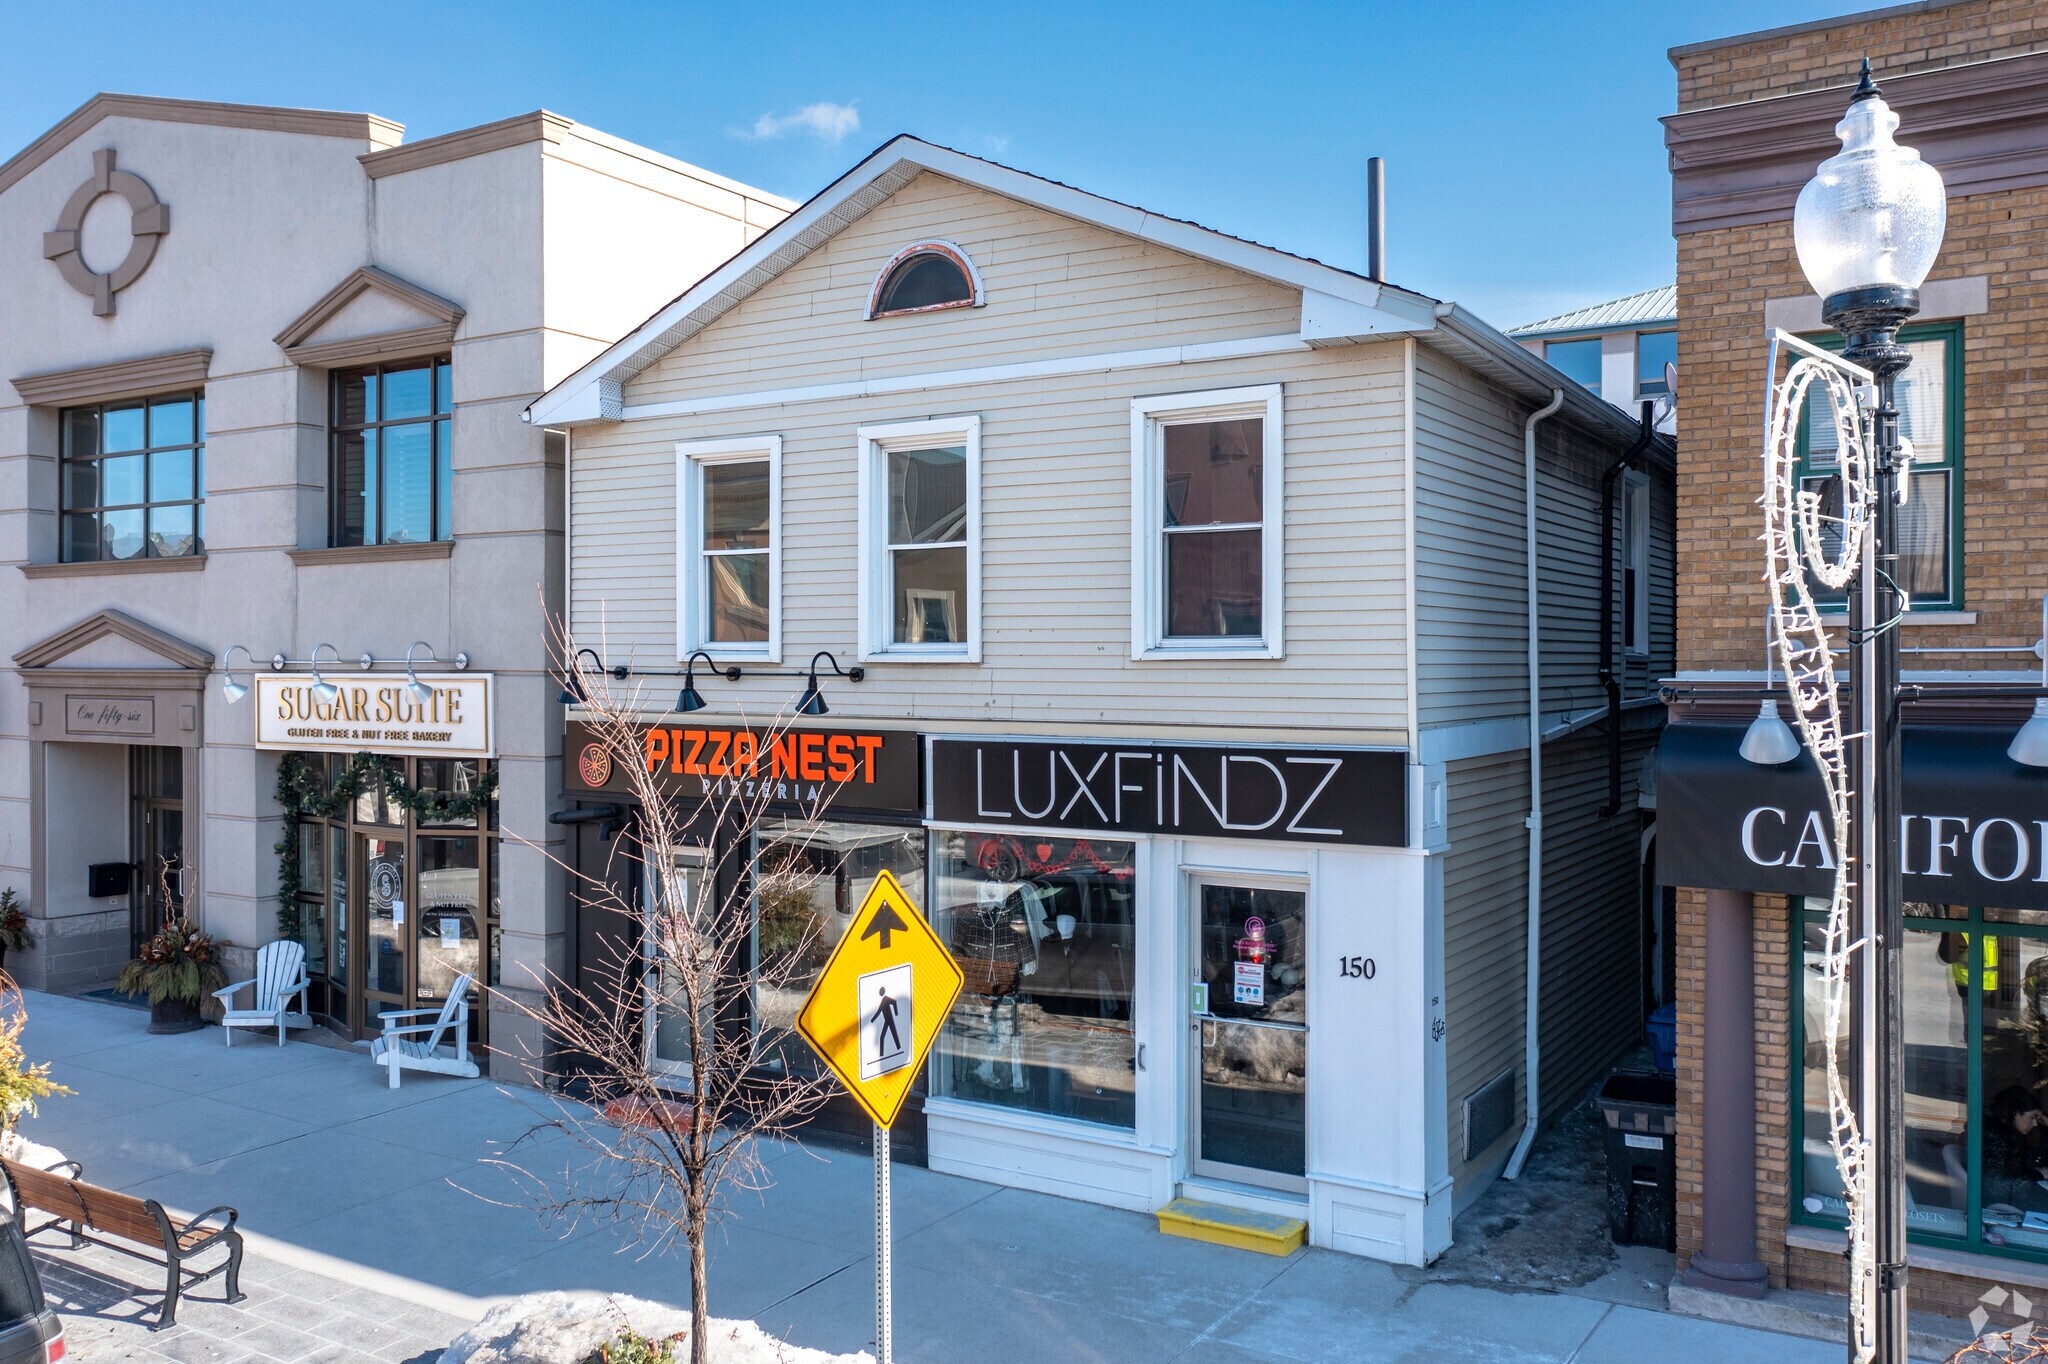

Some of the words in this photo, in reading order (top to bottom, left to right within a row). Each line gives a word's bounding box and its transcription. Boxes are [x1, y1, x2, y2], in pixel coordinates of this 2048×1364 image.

[77, 704, 95, 720] One
[97, 704, 142, 726] fifty-six
[278, 686, 370, 722] SUGAR
[375, 687, 463, 724] SUITE
[287, 727, 323, 739] GLUTEN
[326, 728, 350, 740] FREE
[352, 729, 359, 740] &
[362, 729, 382, 741] NUT
[385, 730, 409, 742] FREE
[412, 731, 452, 743] BAKERY
[646, 729, 759, 778] PIZZA
[771, 733, 883, 784] NEST
[702, 778, 819, 801] PIZZERIA
[1741, 806, 2048, 883] CAIFO
[1339, 955, 1376, 980] 150
